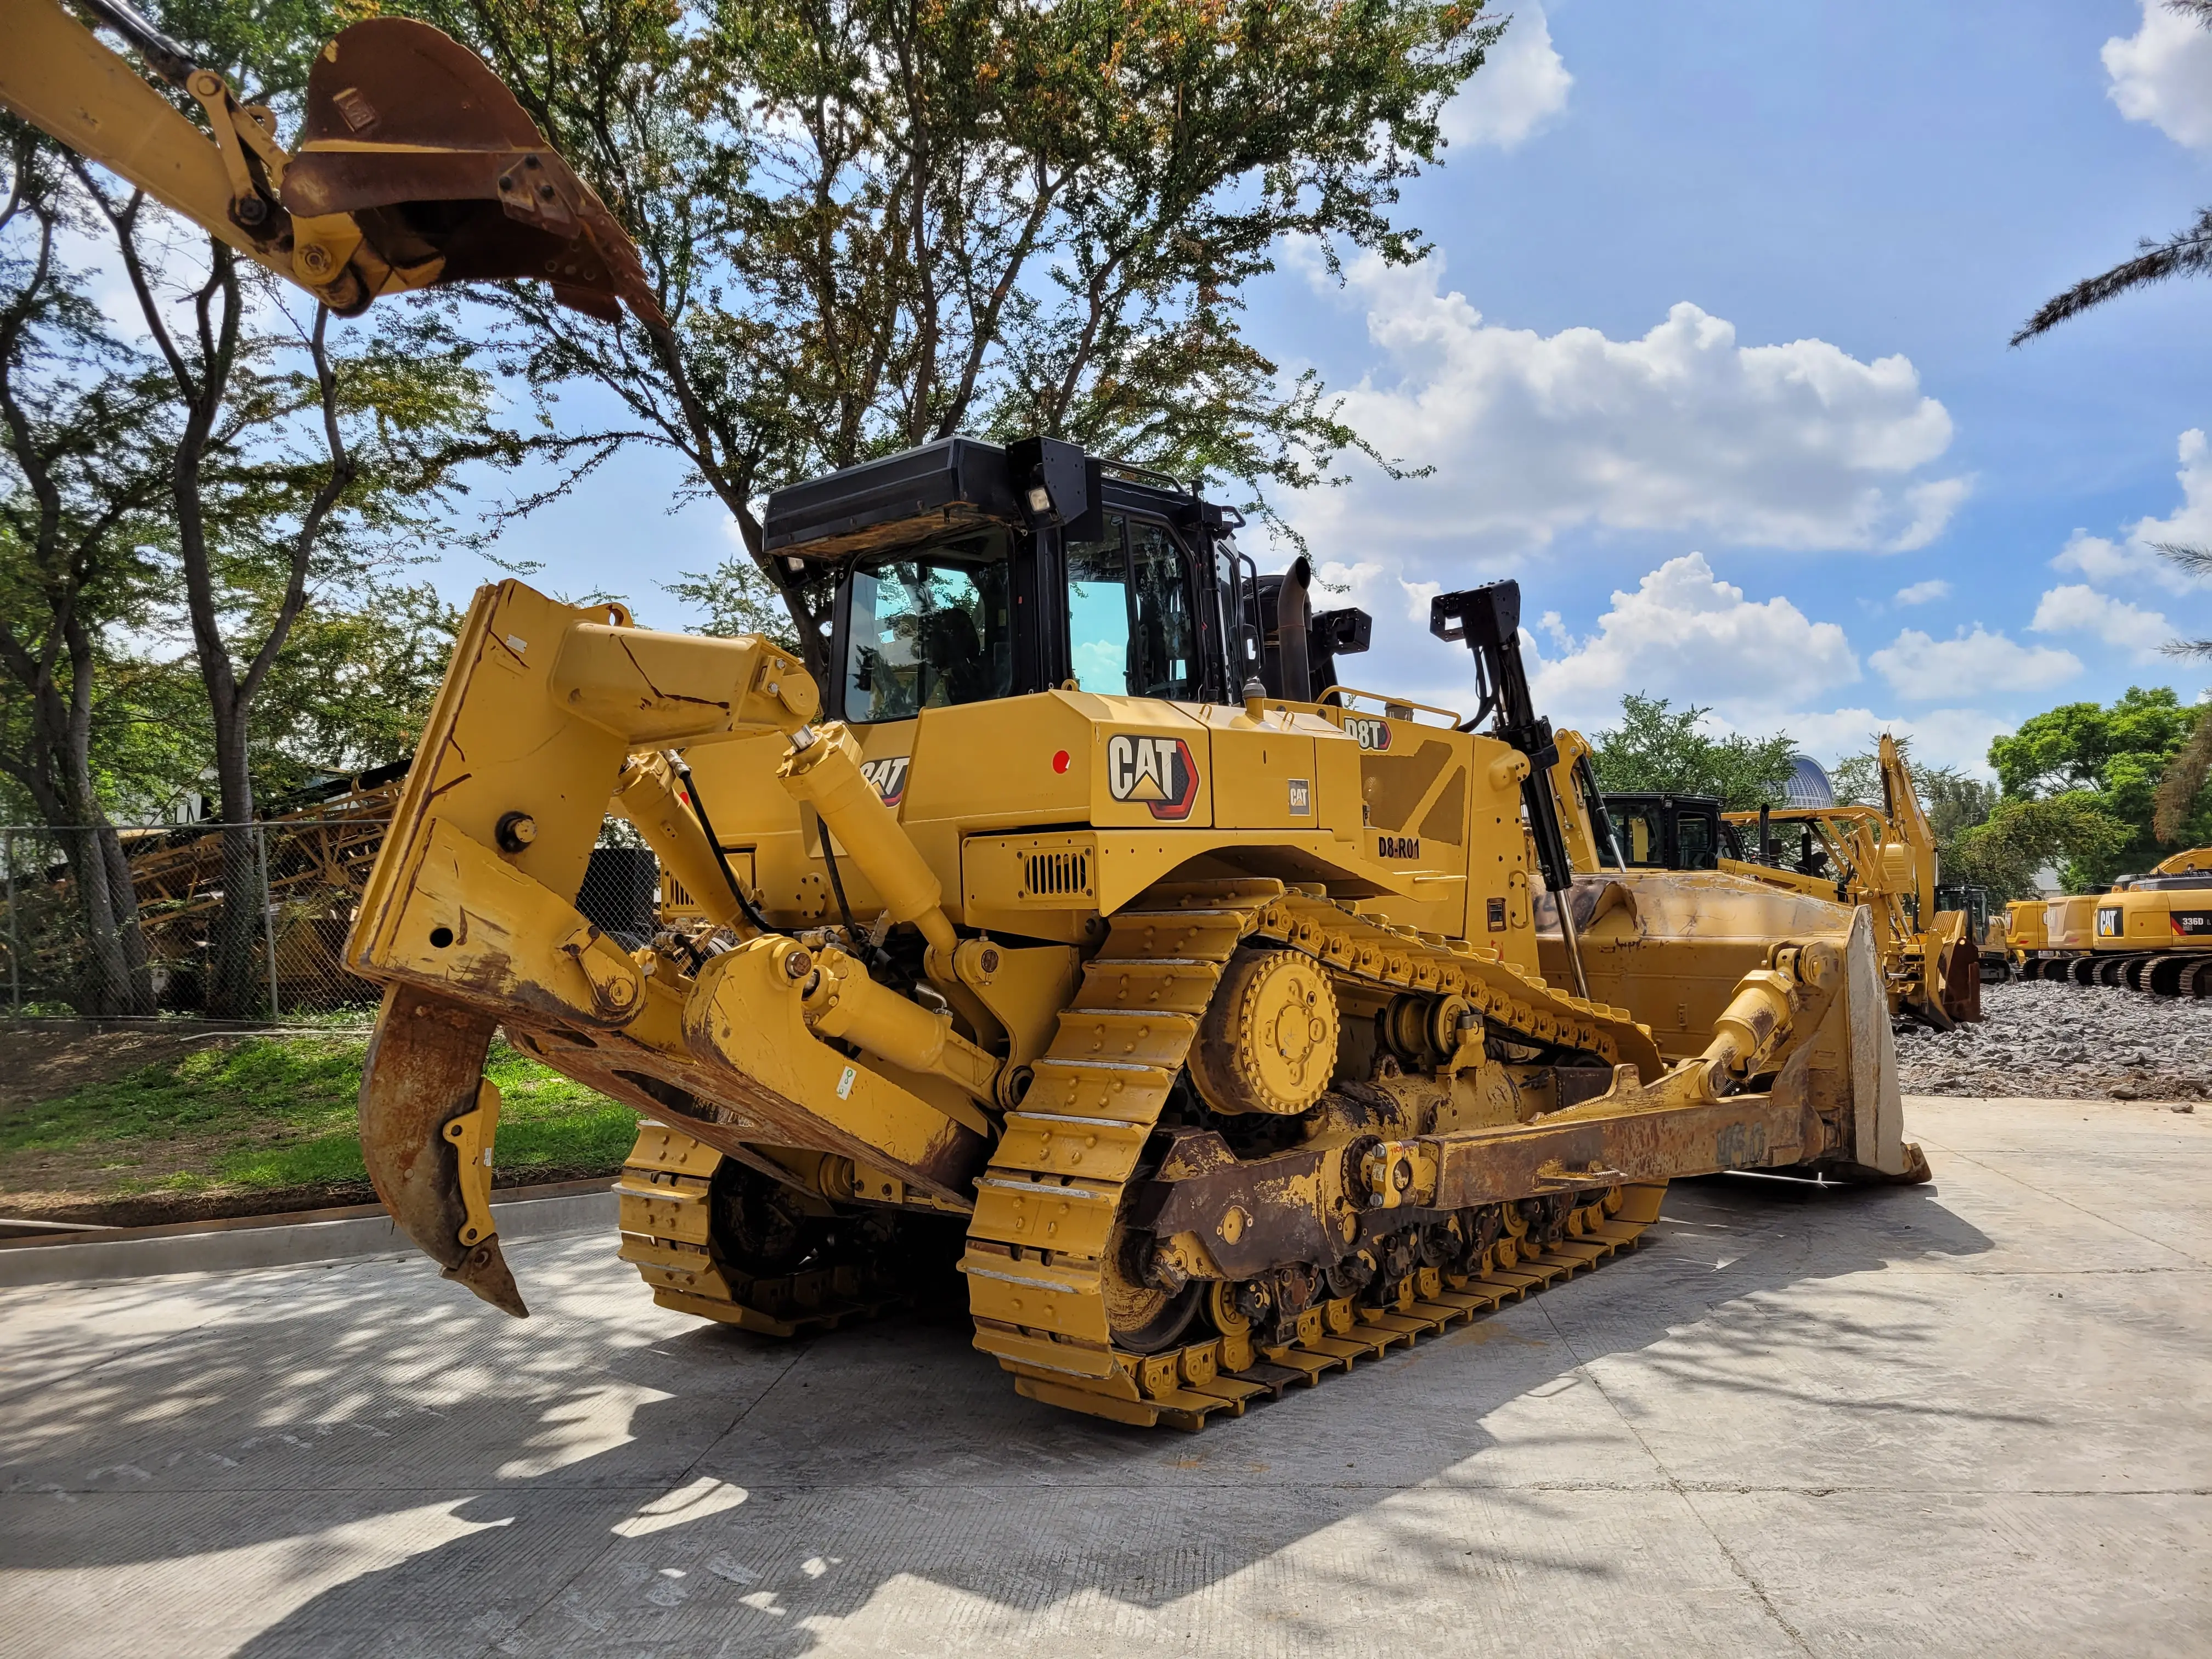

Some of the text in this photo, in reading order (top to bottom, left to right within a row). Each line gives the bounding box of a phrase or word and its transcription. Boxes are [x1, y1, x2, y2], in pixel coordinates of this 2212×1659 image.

[1345, 719, 1381, 748] D8T
[1109, 736, 1177, 800] CAT
[1290, 788, 1307, 806] CAT
[1378, 836, 1420, 860] D8-R01
[2100, 910, 2117, 936] CAT
[2182, 917, 2204, 926] 336D
